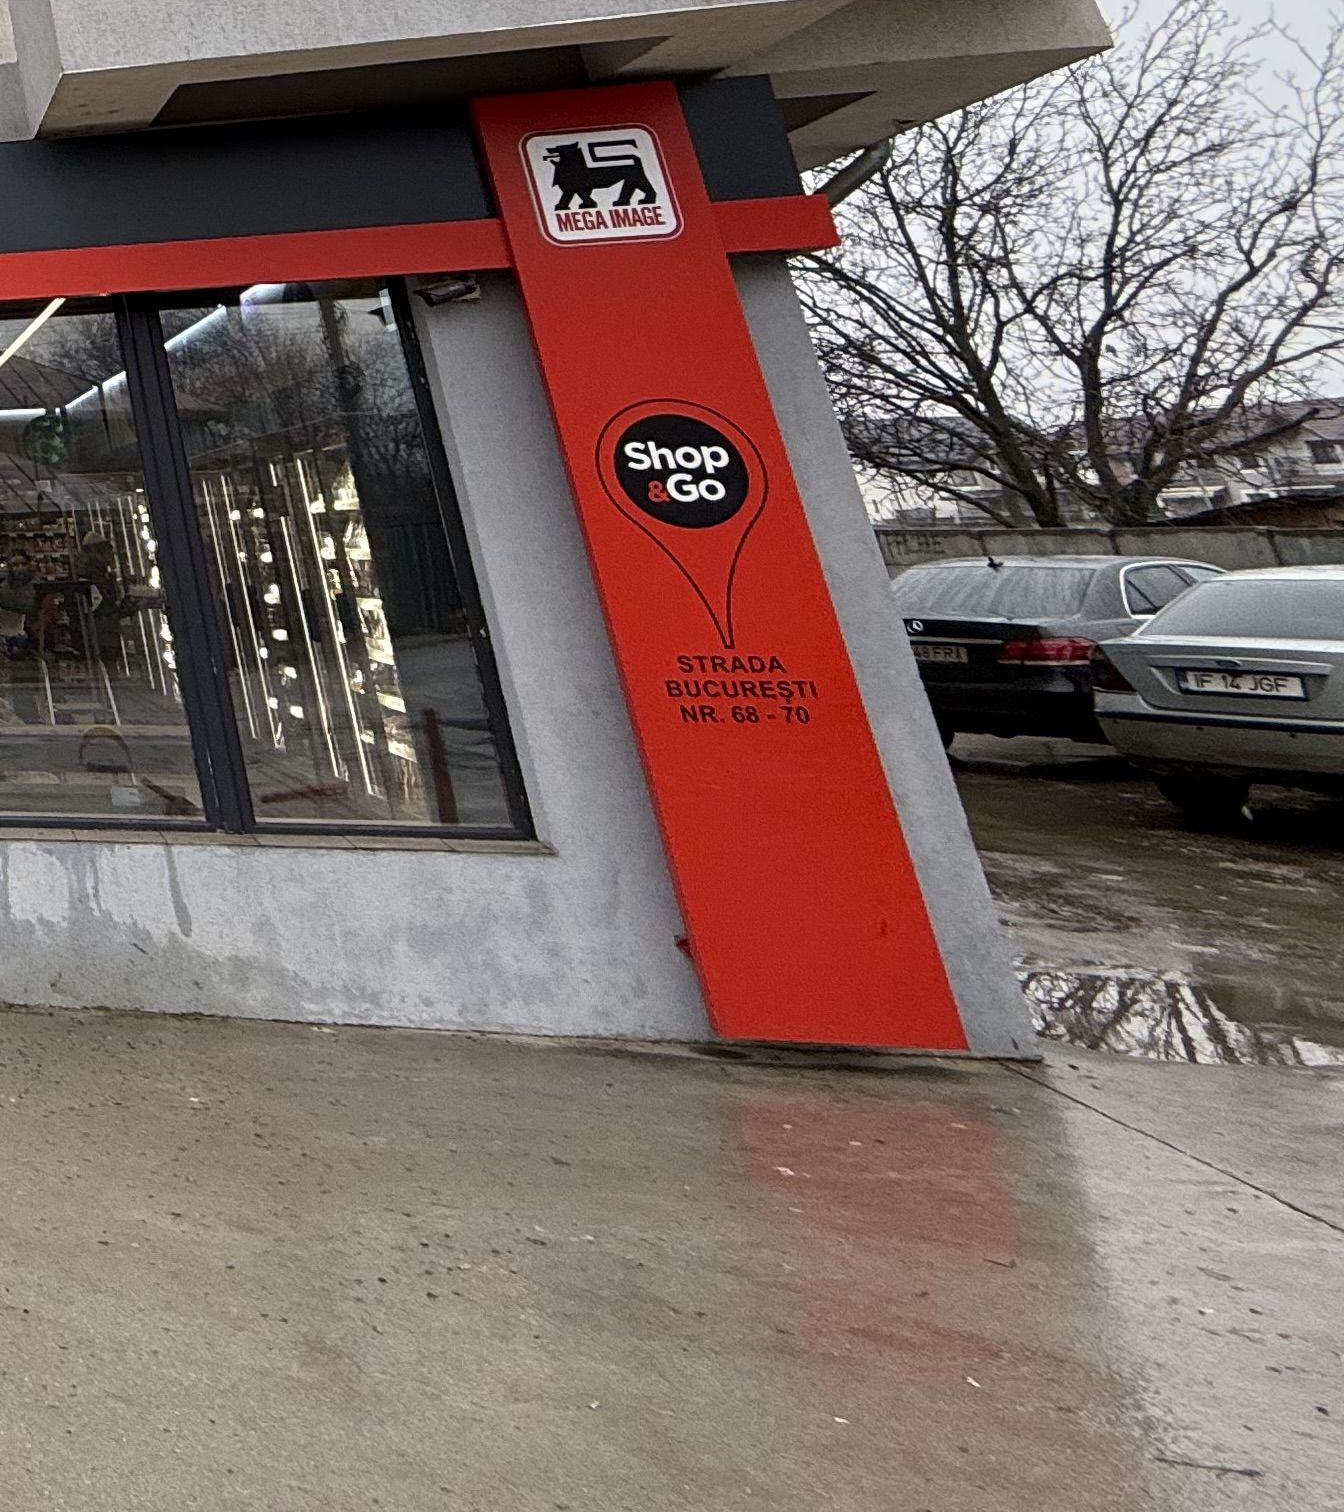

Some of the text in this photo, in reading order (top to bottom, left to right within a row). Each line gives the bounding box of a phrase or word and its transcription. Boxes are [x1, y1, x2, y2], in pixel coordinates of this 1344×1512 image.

[555, 205, 666, 233] MEGA IMAGE
[623, 441, 730, 473] Shop
[648, 473, 726, 503] &Go
[677, 655, 788, 674] STRADA
[665, 679, 819, 704] BUCUREȘTI
[680, 704, 725, 724] NR.
[731, 705, 760, 724] 68
[781, 705, 811, 725] 70
